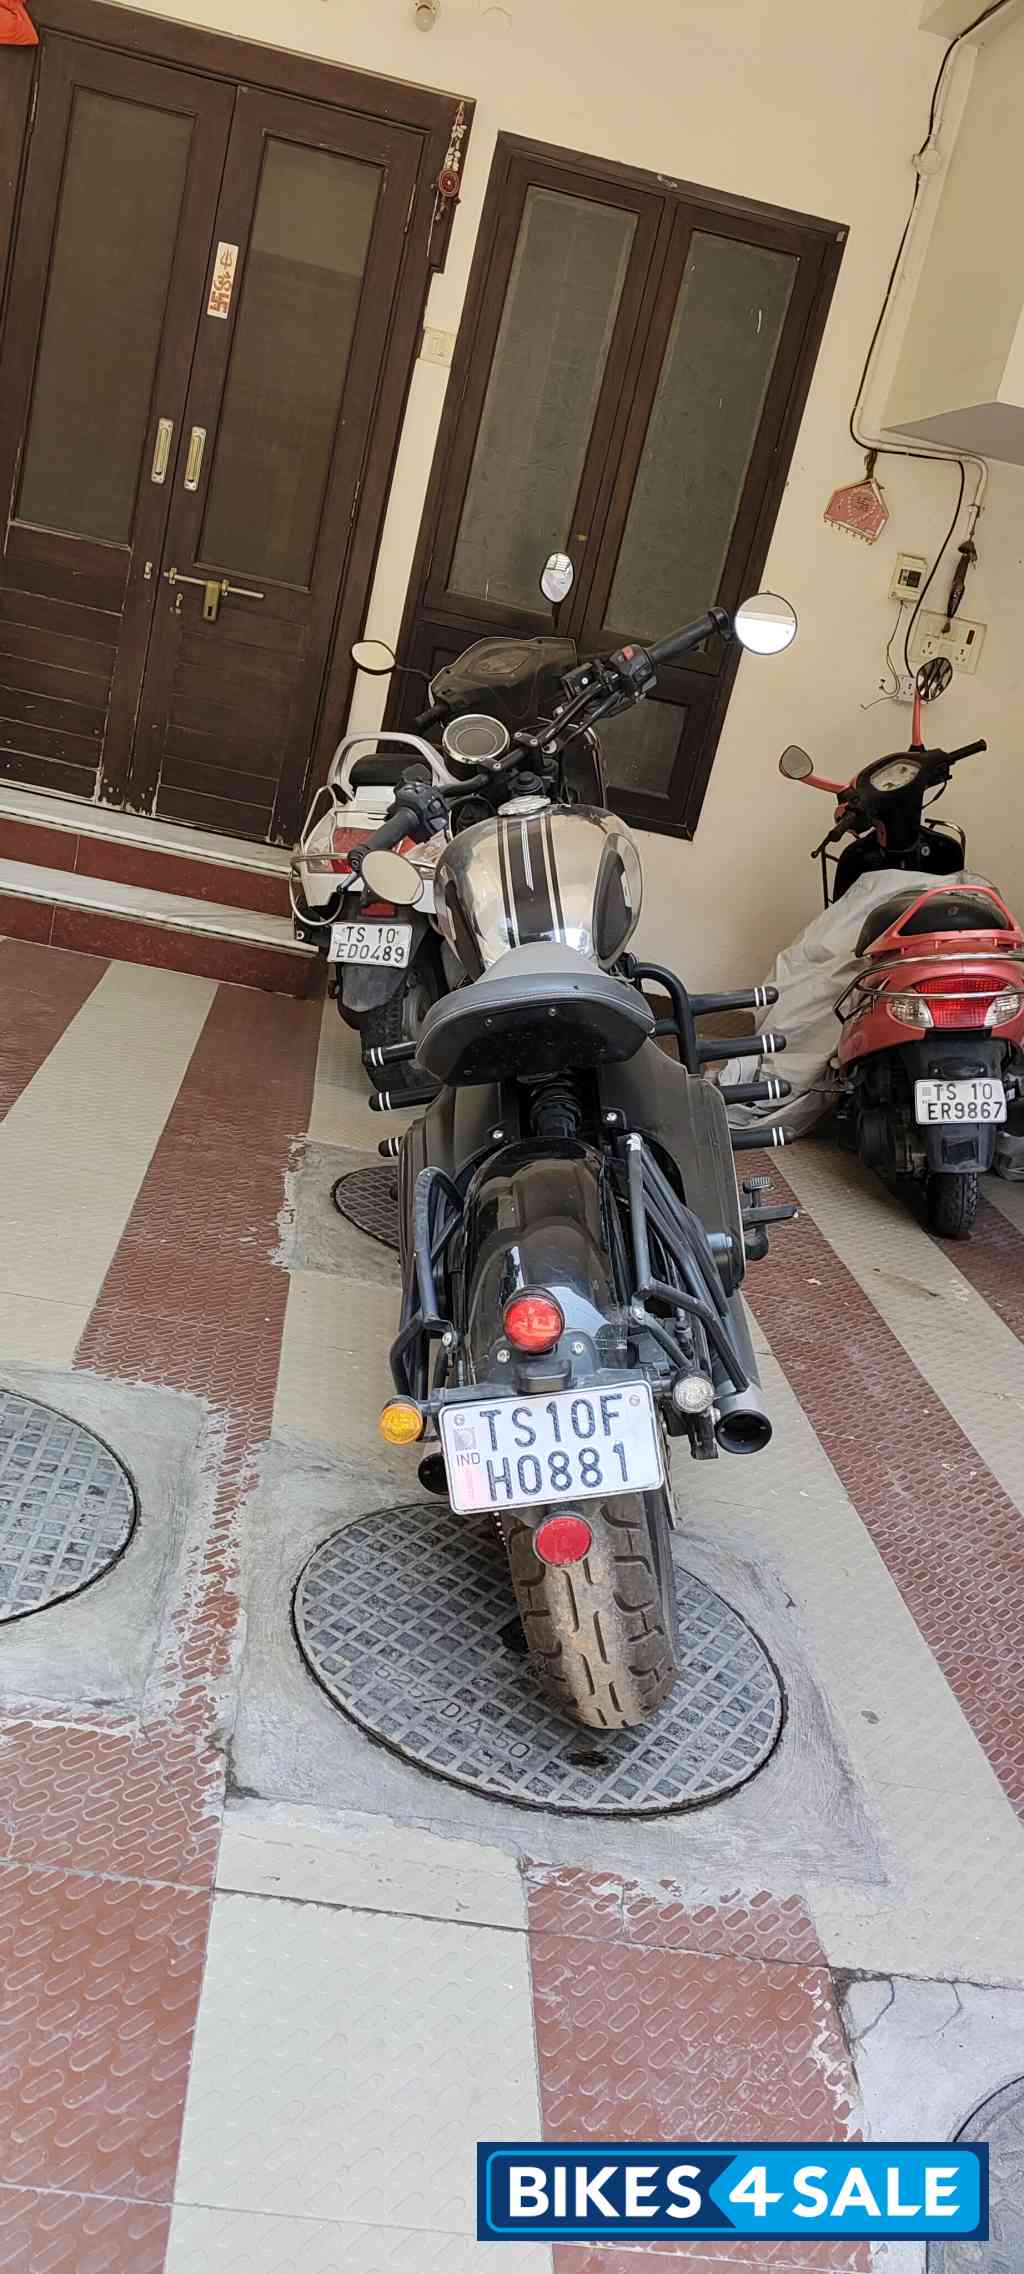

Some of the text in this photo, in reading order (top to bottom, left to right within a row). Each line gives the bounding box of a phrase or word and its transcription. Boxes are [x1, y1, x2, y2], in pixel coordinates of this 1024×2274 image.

[346, 926, 396, 944] TS 10
[336, 943, 405, 963] ED0489
[933, 1082, 993, 1101] TS 10
[928, 1101, 1003, 1121] ER9867
[479, 1393, 623, 1451] TS10F
[455, 1451, 481, 1466] IND
[486, 1440, 629, 1501] H0881
